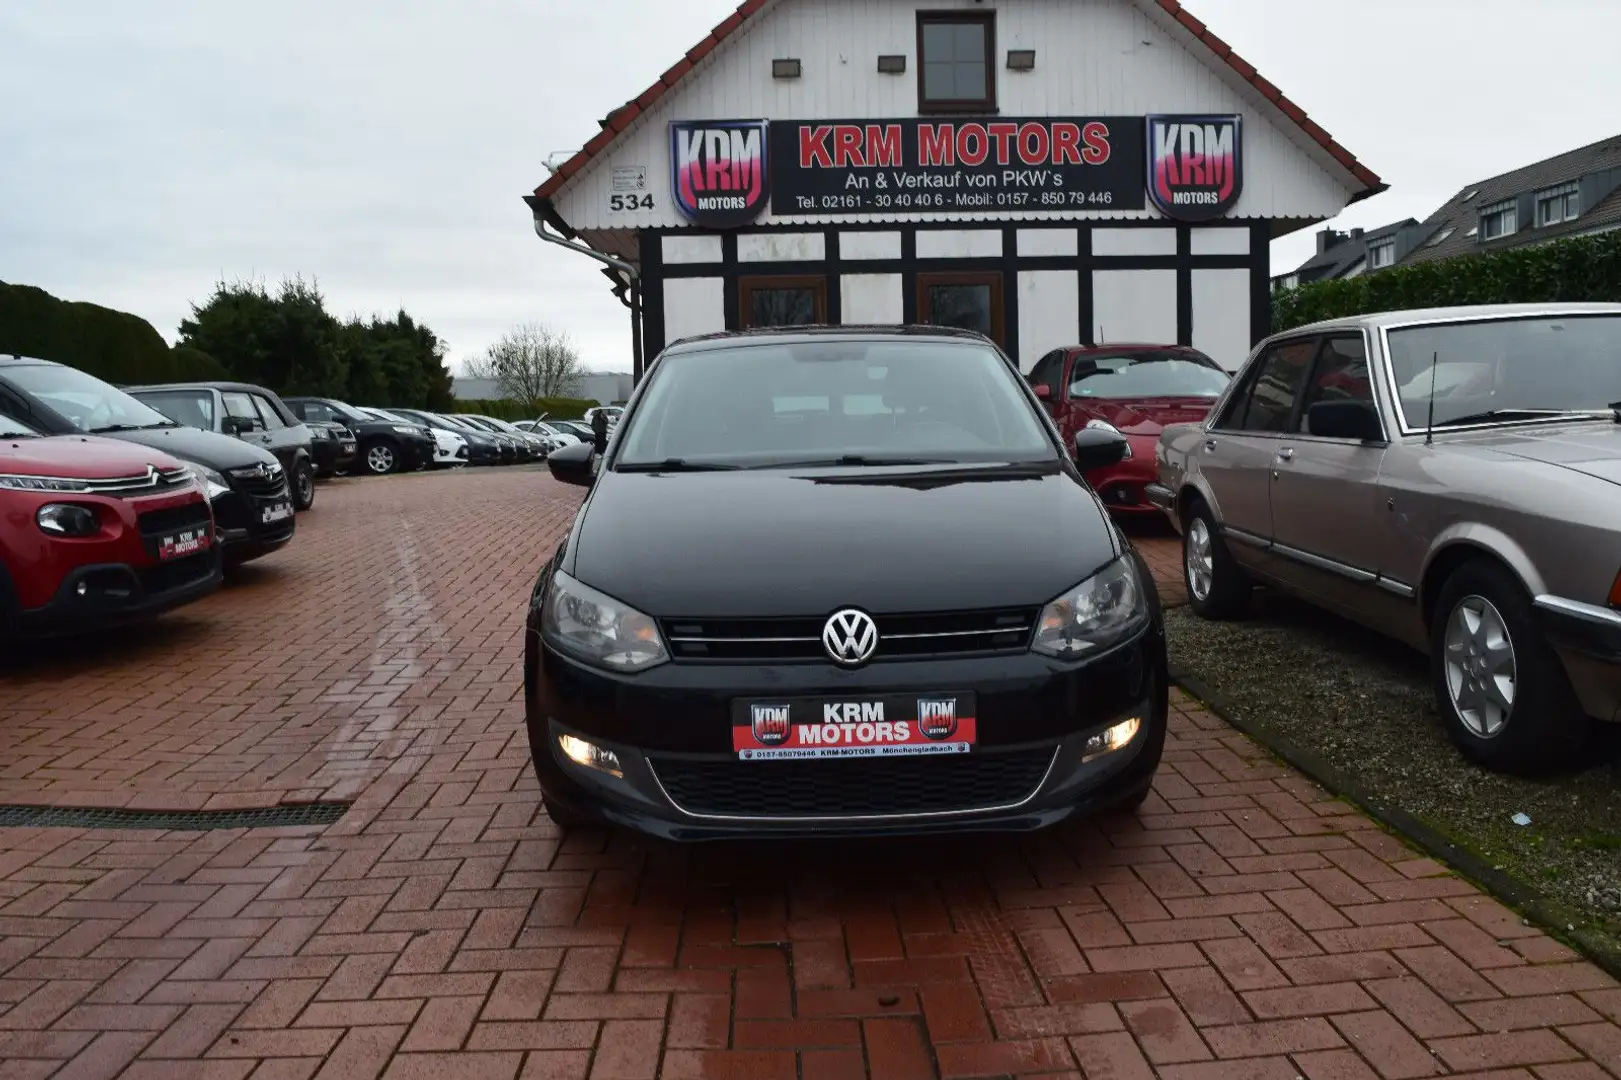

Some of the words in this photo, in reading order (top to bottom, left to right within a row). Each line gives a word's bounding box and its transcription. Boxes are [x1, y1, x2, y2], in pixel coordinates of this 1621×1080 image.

[799, 124, 903, 168] KRM
[917, 121, 1111, 167] MOTORS
[1155, 123, 1234, 186] KRM
[677, 128, 762, 192] KRM
[845, 172, 870, 190] An
[875, 172, 888, 189] &
[893, 171, 962, 188] Verkauf
[965, 174, 997, 187] von
[610, 193, 655, 211] 534
[698, 197, 745, 210] MOTORS
[796, 194, 818, 209] Tel.
[822, 195, 862, 208] 02161
[875, 194, 891, 207] 30
[894, 193, 911, 206] 40
[914, 193, 931, 206] 40
[934, 193, 943, 206] 6
[955, 192, 993, 206] Mobil:
[997, 191, 1029, 205] 0157
[1041, 191, 1065, 205] 850
[1069, 191, 1085, 204] 79
[1088, 190, 1112, 204] 446
[1173, 192, 1218, 205] MOTORS
[822, 608, 877, 663] VW
[823, 702, 885, 723] KRM
[798, 721, 910, 744] MOTORS
[820, 748, 876, 757] KRM-MOTORS
[882, 745, 953, 755] Mönchengladbach
